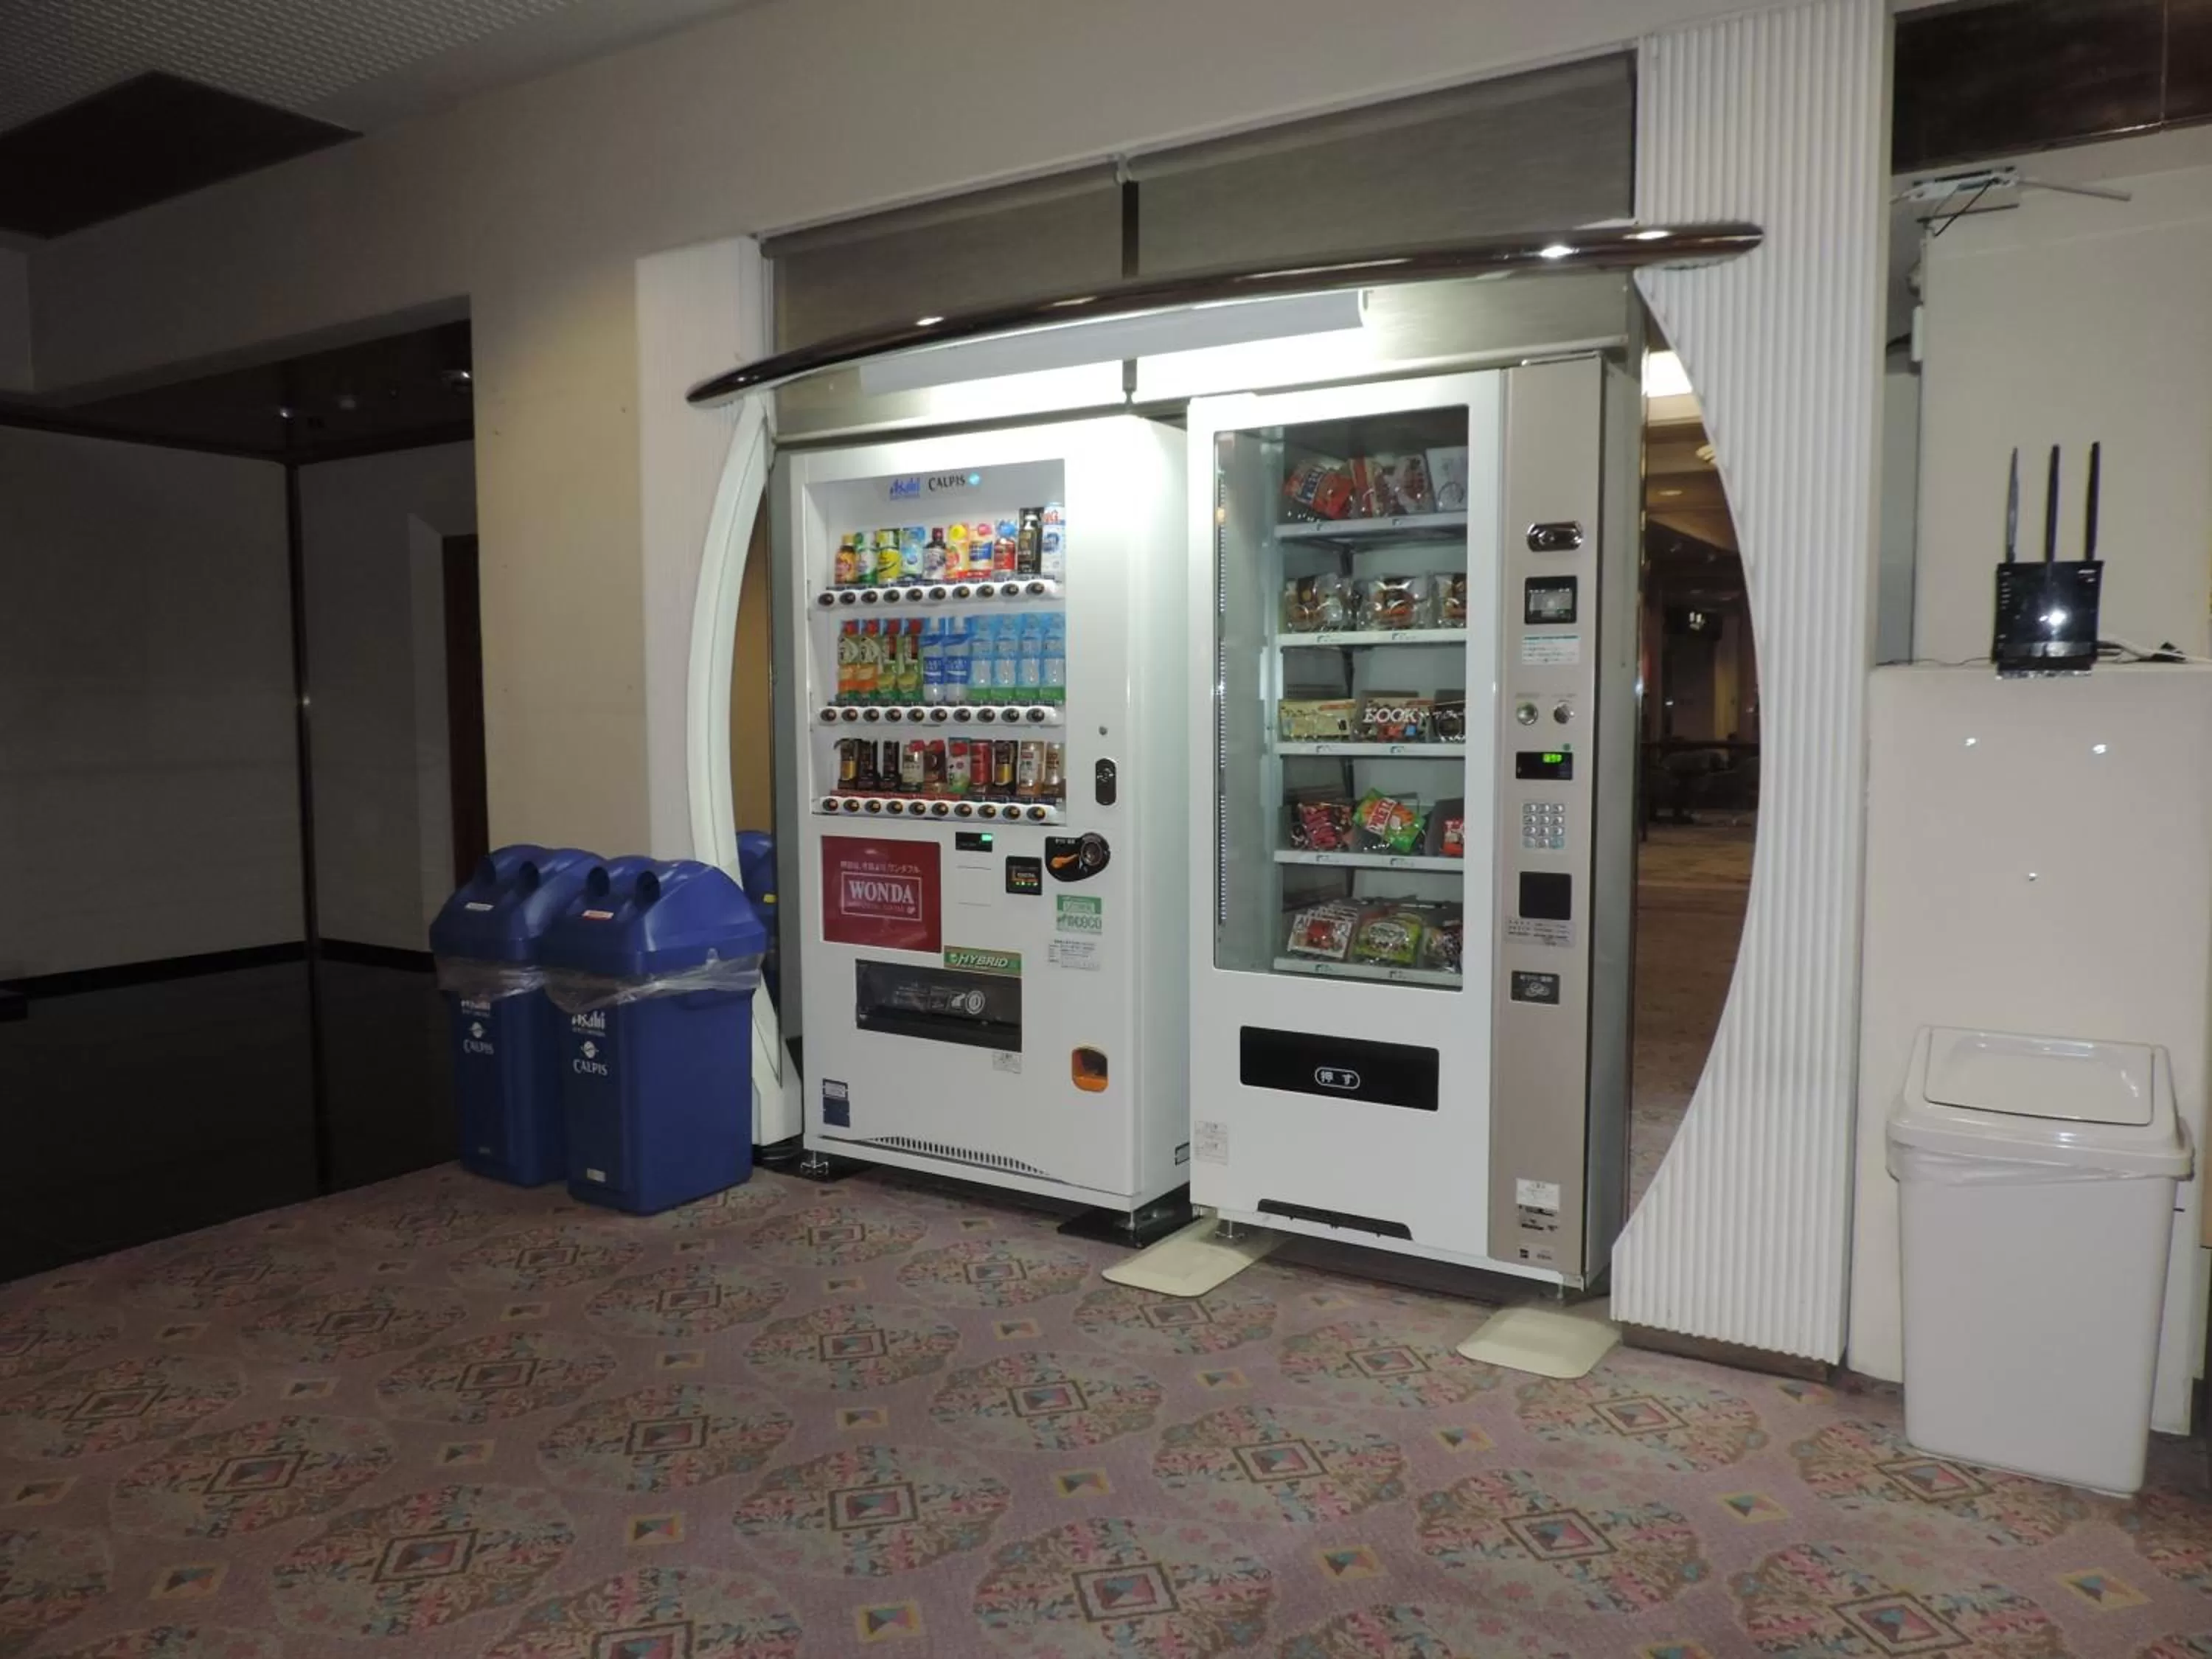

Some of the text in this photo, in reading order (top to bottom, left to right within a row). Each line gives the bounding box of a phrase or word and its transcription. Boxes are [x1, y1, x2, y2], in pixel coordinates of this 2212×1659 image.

[928, 474, 965, 492] CALPIS
[849, 880, 914, 904] WONDA
[957, 954, 1009, 968] HYBRID
[463, 1038, 495, 1055] CALPIS
[572, 1058, 608, 1077] CALPIS
[1321, 1070, 1354, 1086] 押す
